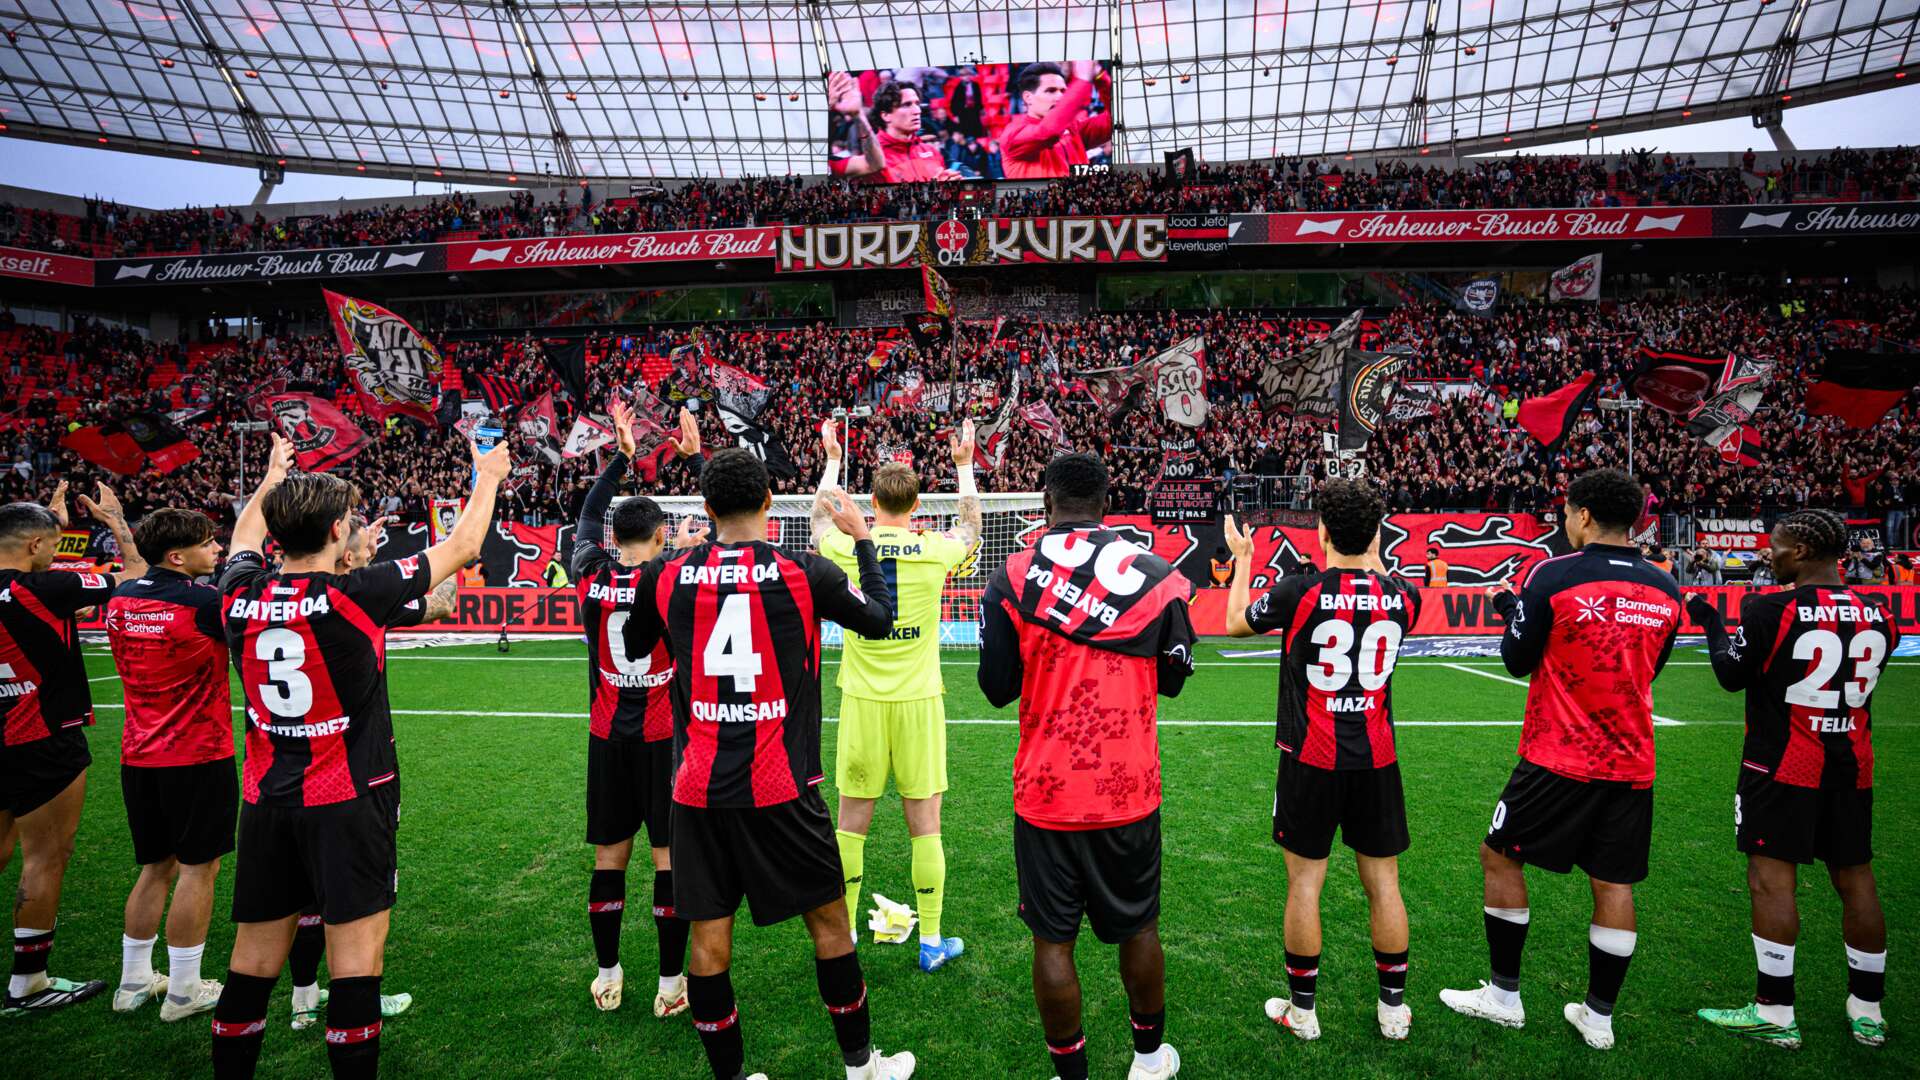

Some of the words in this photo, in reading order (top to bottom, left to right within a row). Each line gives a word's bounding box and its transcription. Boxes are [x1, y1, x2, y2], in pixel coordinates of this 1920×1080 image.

[1168, 216, 1197, 227] Jood
[1348, 213, 1559, 238] Anheuser-Busch
[1563, 212, 1631, 235] Bud
[514, 233, 700, 264] Anheuser-Busch
[705, 231, 766, 255] Bud
[782, 223, 921, 270] NORD
[987, 218, 1167, 261] KURVE
[1168, 240, 1228, 252] Leverkusen
[156, 254, 324, 281] Anheuser-Busch
[327, 251, 381, 274] Bud
[938, 249, 966, 265] 04
[881, 300, 906, 311] EUC
[1697, 519, 1765, 533] YOUNG
[903, 544, 922, 555] 04
[1704, 534, 1757, 548] BOYS
[680, 565, 748, 585] BAYER
[752, 563, 780, 583] 04
[1025, 564, 1053, 588] 04
[229, 599, 298, 621] BAYER
[299, 594, 329, 616] 04
[1052, 577, 1120, 627] BAYER
[1320, 594, 1379, 610] BAYER
[1381, 594, 1403, 610] 04
[1615, 597, 1672, 617] Barmenia
[124, 610, 174, 621] Barmenia
[1615, 611, 1664, 627] Gothaer
[1798, 606, 1862, 622] BAYER
[1864, 606, 1884, 622] 04
[125, 623, 165, 634] Gothaer
[704, 593, 763, 693] 4
[1306, 619, 1403, 691] 30
[255, 628, 313, 717] 3
[600, 668, 674, 688] ERNANDEZ
[1784, 628, 1887, 710] 23
[692, 699, 786, 722] QUANSAH
[1326, 696, 1376, 712] MAZA
[1808, 715, 1856, 733] TELLA
